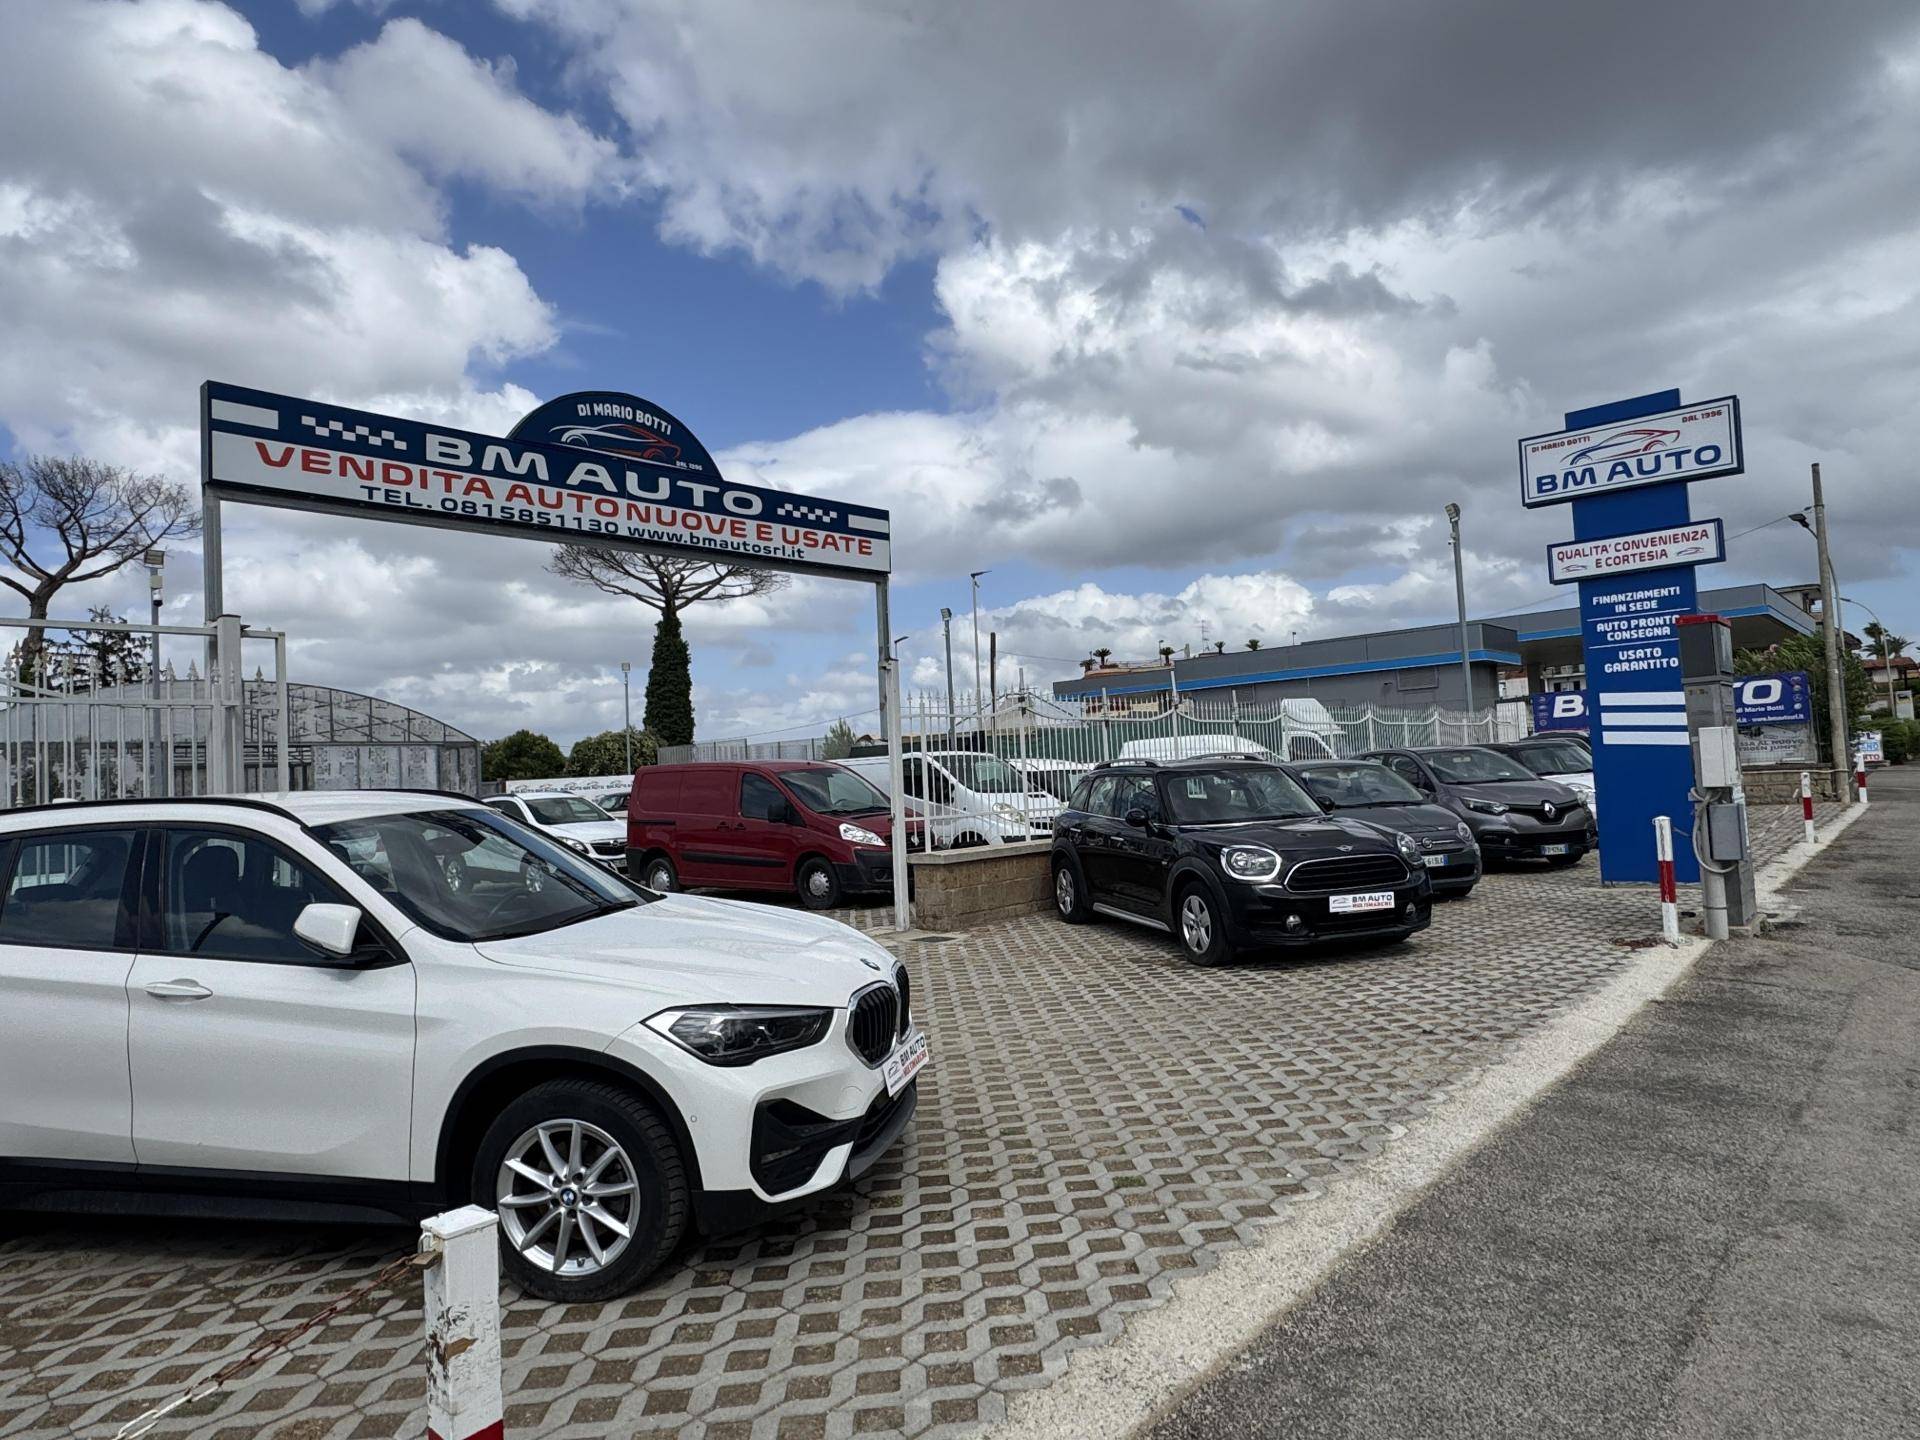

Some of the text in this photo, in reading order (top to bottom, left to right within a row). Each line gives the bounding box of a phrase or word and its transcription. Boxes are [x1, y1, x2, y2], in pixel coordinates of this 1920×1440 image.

[577, 403, 672, 436] DI MARIO BOTTI
[1541, 441, 1565, 451] MARIO
[1566, 435, 1591, 446] BOTTI
[426, 433, 763, 516] BM AUTO
[1536, 444, 1722, 494] BM AUTO
[255, 441, 872, 556] VENDITA AUTO NUOVE E USATE
[441, 498, 618, 535] 0815851130
[627, 524, 805, 559] www.bmautosrl.it
[1614, 529, 1709, 552] CONVENIENZA
[1595, 548, 1669, 568] E CORTESIA
[1592, 586, 1680, 605] FINANZIAMENTI
[1615, 600, 1658, 613] IN SEDE
[1596, 621, 1628, 632] AUTO
[1607, 626, 1671, 641] CONSEGNA
[1618, 647, 1662, 660] USATO
[1604, 657, 1679, 674] GARANTITO
[1553, 694, 1589, 718] B
[1368, 894, 1393, 902] AUTO
[909, 1036, 925, 1056] AUTO
